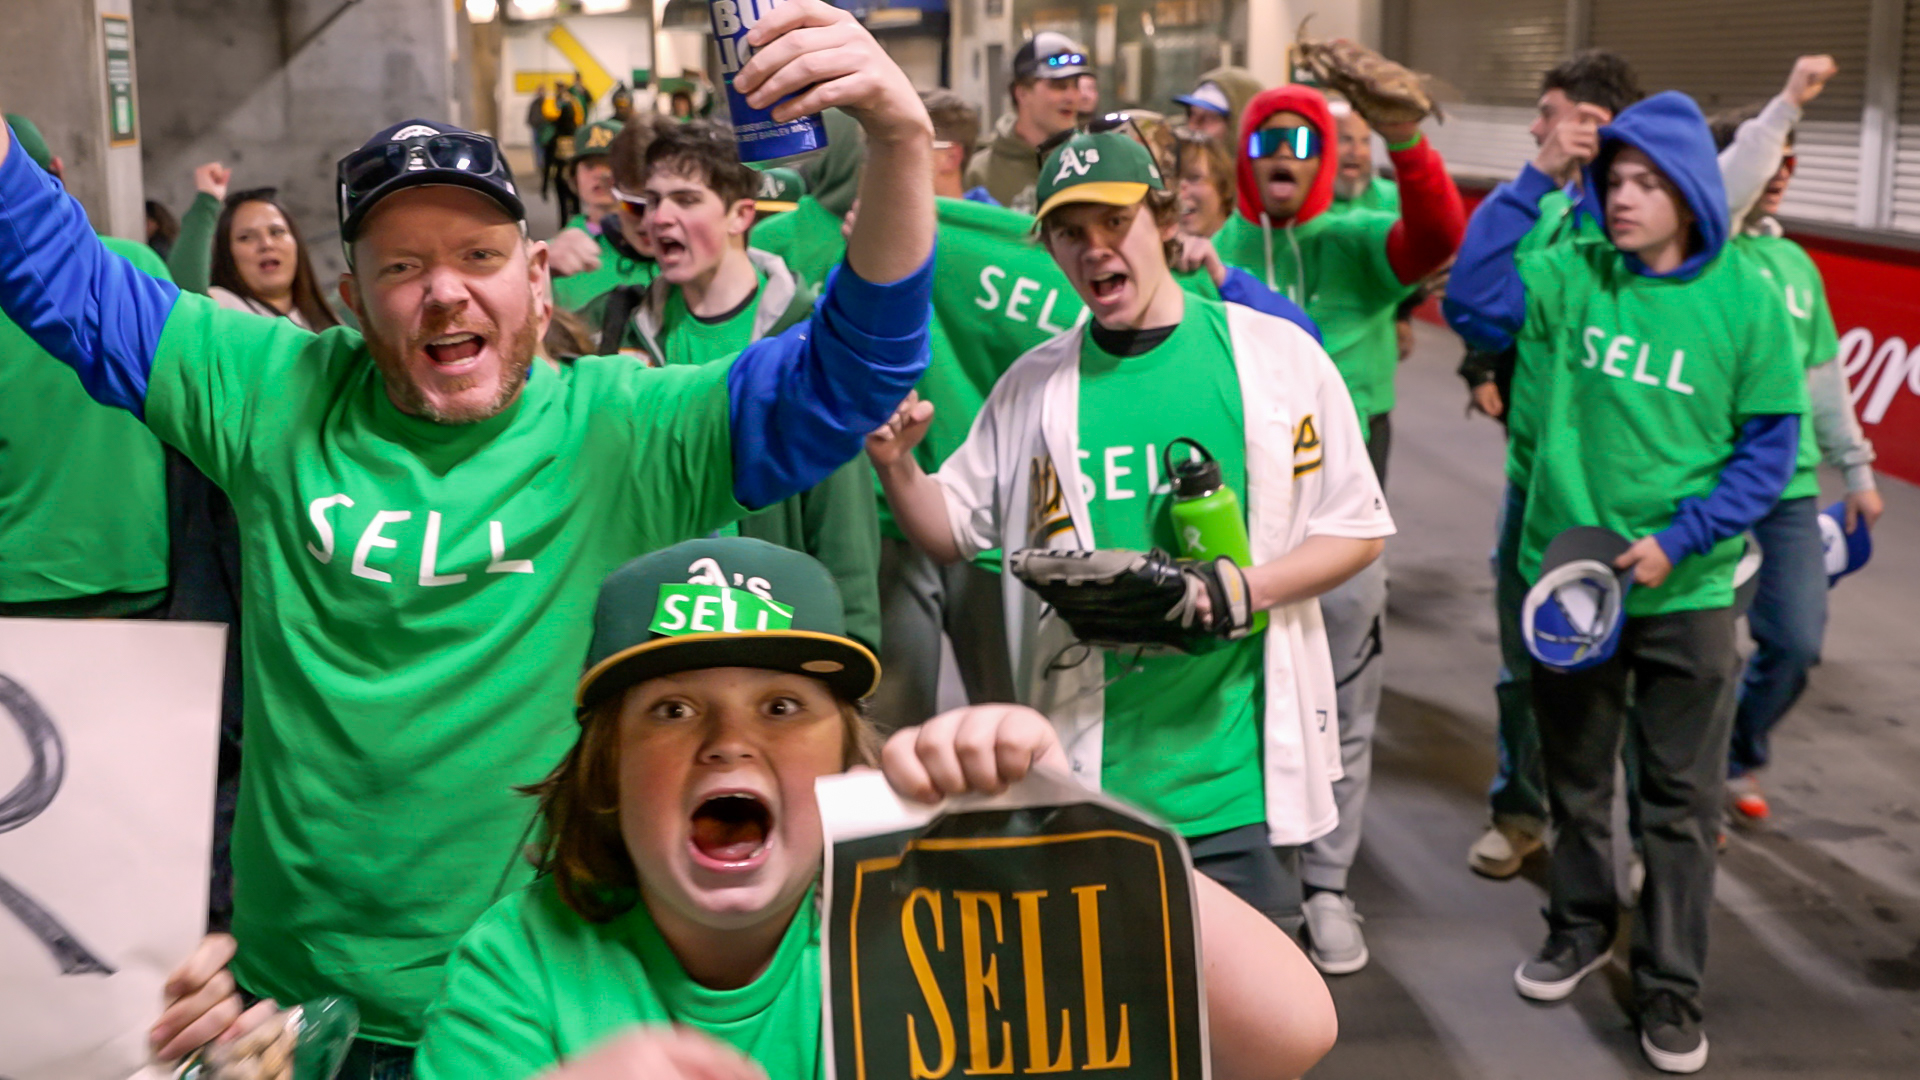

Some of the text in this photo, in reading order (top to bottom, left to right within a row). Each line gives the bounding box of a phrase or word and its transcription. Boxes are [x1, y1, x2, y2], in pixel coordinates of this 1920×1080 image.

[1052, 146, 1100, 187] A's
[1580, 325, 1695, 396] SELL
[306, 493, 535, 587] SELL
[901, 884, 1131, 1080] SELL
